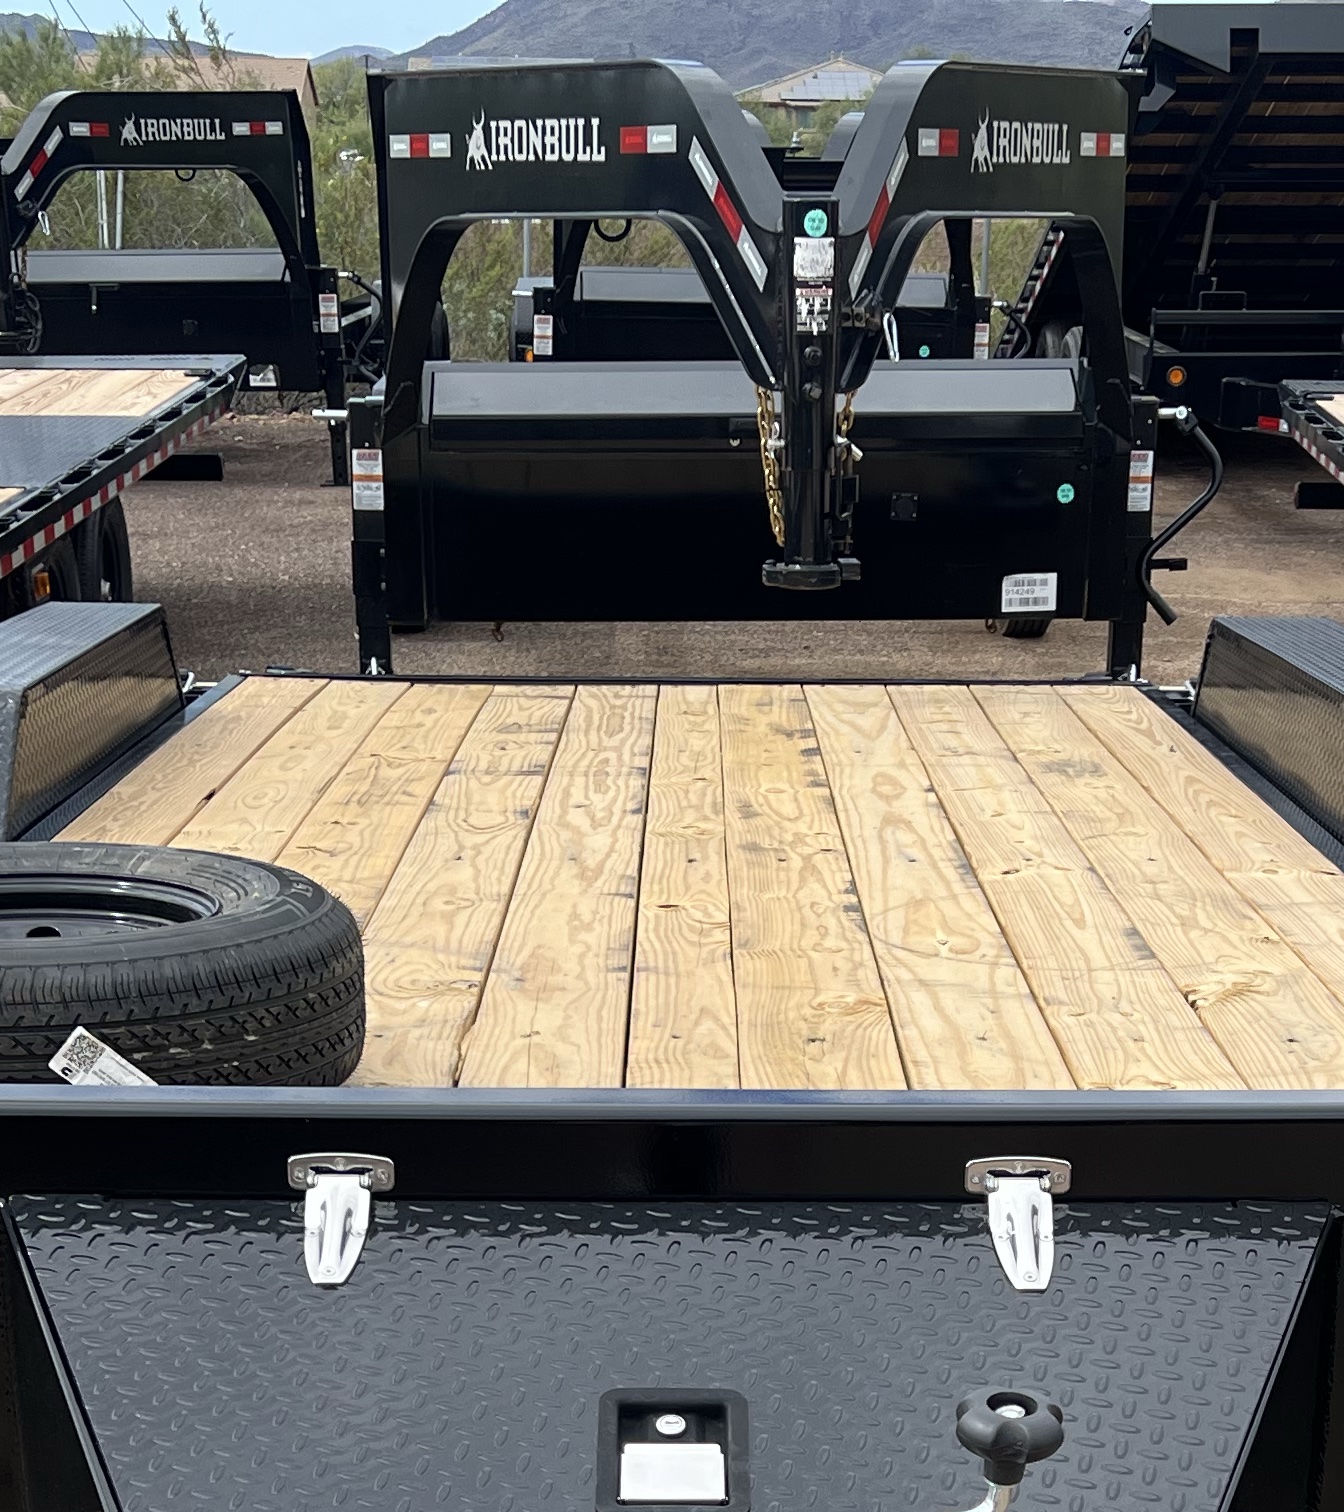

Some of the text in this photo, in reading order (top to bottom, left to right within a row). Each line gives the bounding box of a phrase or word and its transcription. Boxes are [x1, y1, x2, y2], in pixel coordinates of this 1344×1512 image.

[140, 118, 226, 142] IRONBULL
[490, 117, 605, 162] IRONBULL
[992, 120, 1071, 164] IRONBULL
[1004, 587, 1036, 597] 914249
